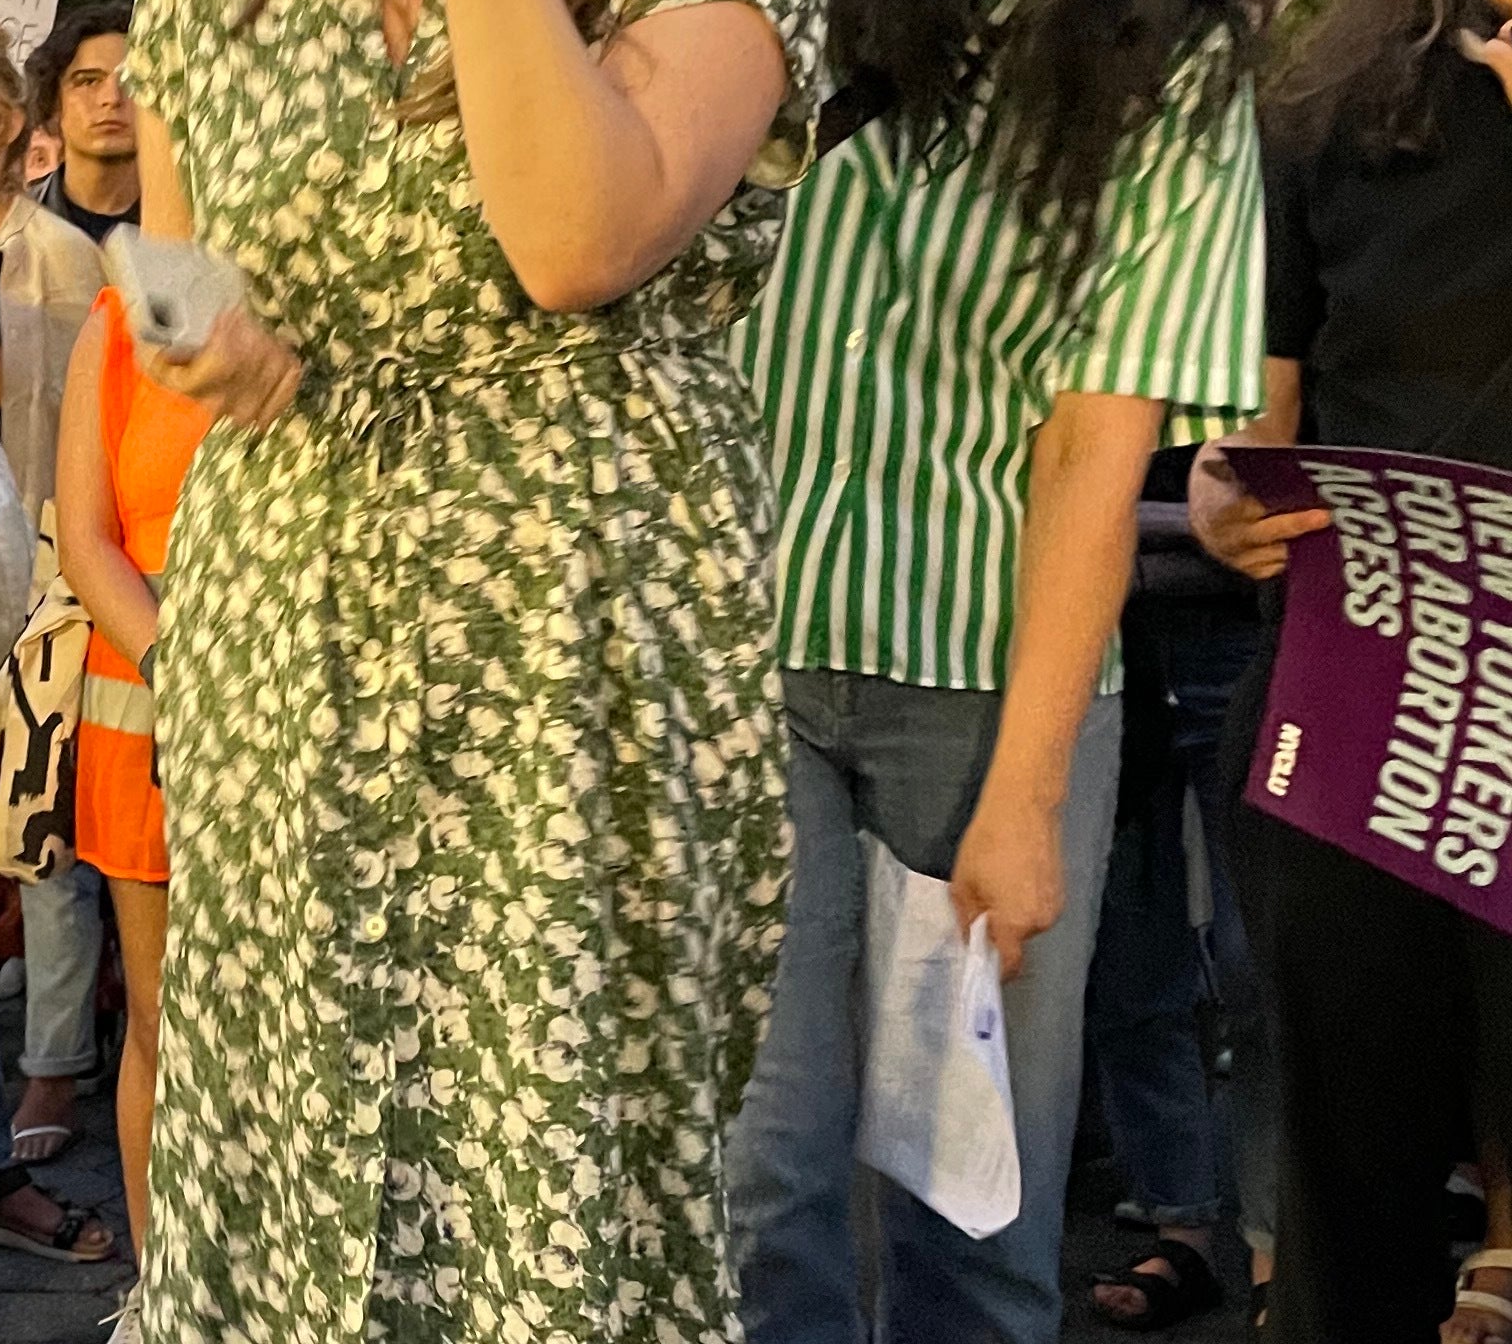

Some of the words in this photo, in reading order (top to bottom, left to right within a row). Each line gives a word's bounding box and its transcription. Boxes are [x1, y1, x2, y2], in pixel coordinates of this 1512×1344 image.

[1298, 459, 1403, 638] ACCESS
[1384, 468, 1468, 563] FOR
[1368, 560, 1473, 853] ABORTION
